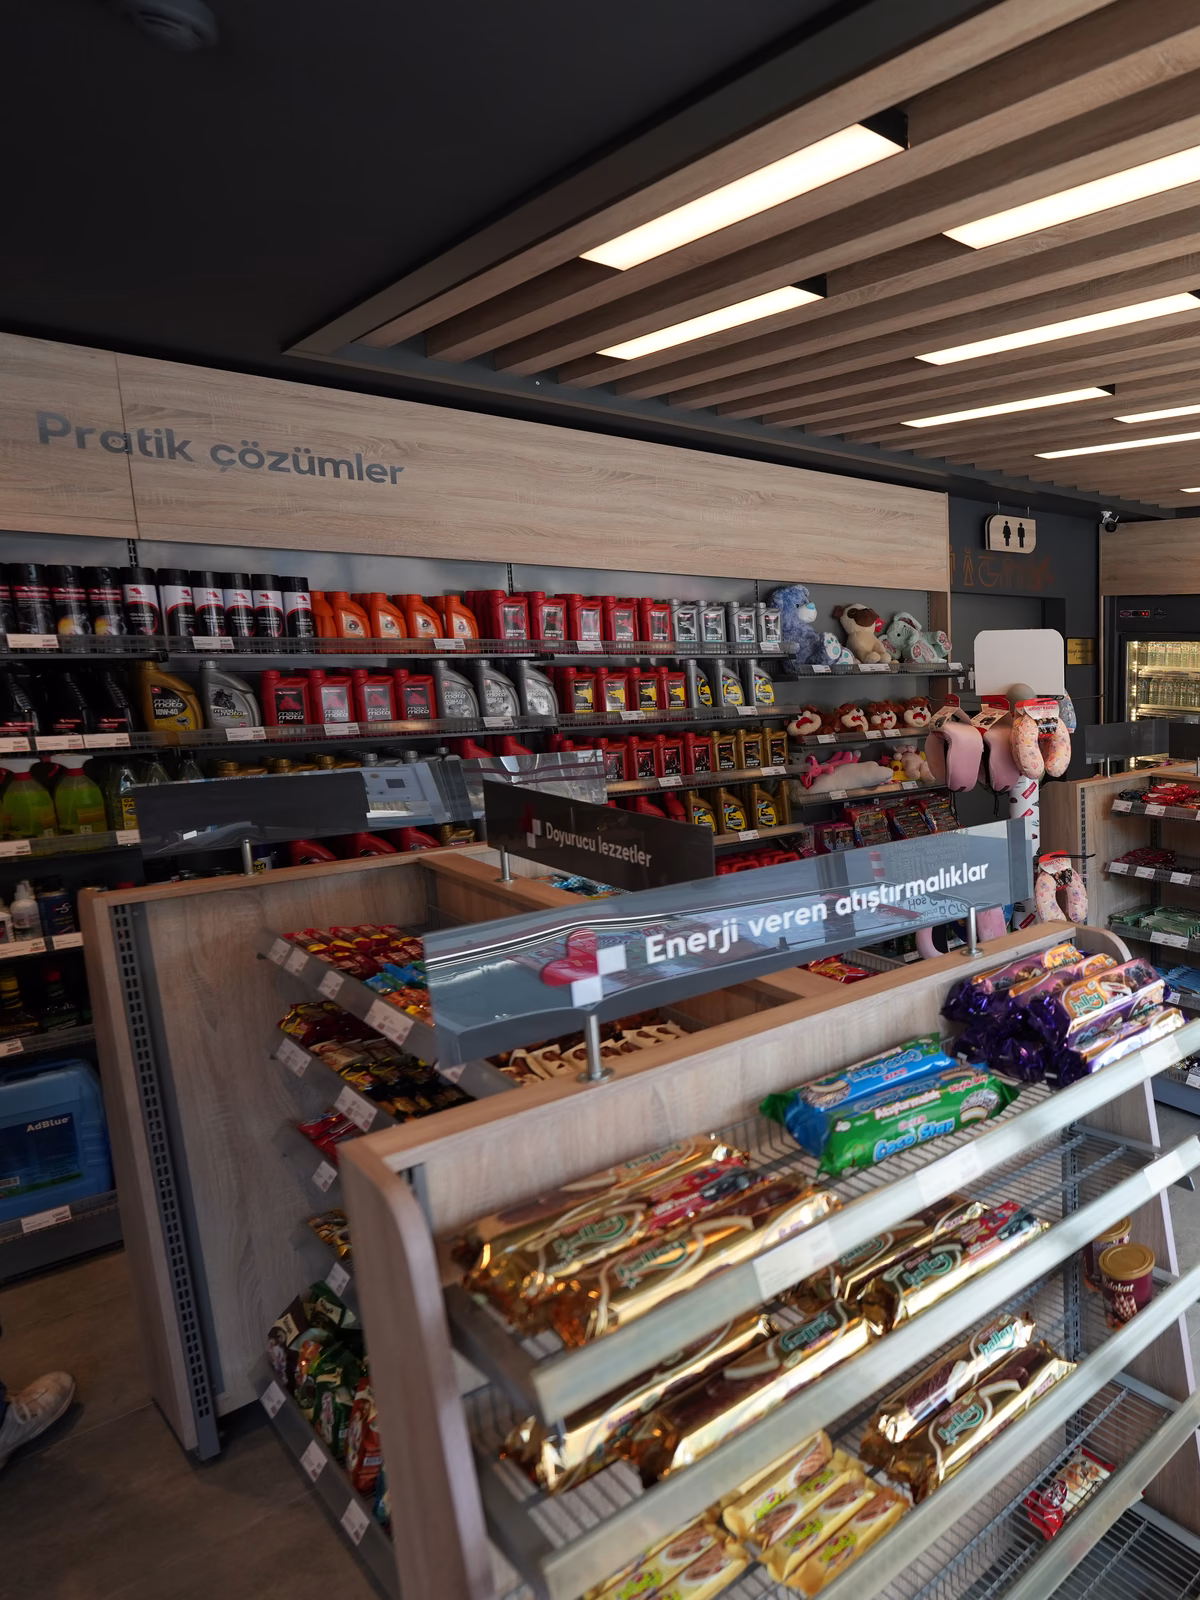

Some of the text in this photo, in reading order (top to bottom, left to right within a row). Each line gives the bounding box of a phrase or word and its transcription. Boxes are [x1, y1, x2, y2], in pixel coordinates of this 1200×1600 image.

[36, 411, 405, 485] Pratik çözümler
[545, 821, 653, 868] Doyurucu lezzetler
[645, 917, 740, 965] Enerji
[748, 902, 828, 938] veren
[834, 861, 990, 913] atıştırmalıklar
[26, 1116, 70, 1133] AdBlue
[873, 1117, 956, 1162] Coco Star
